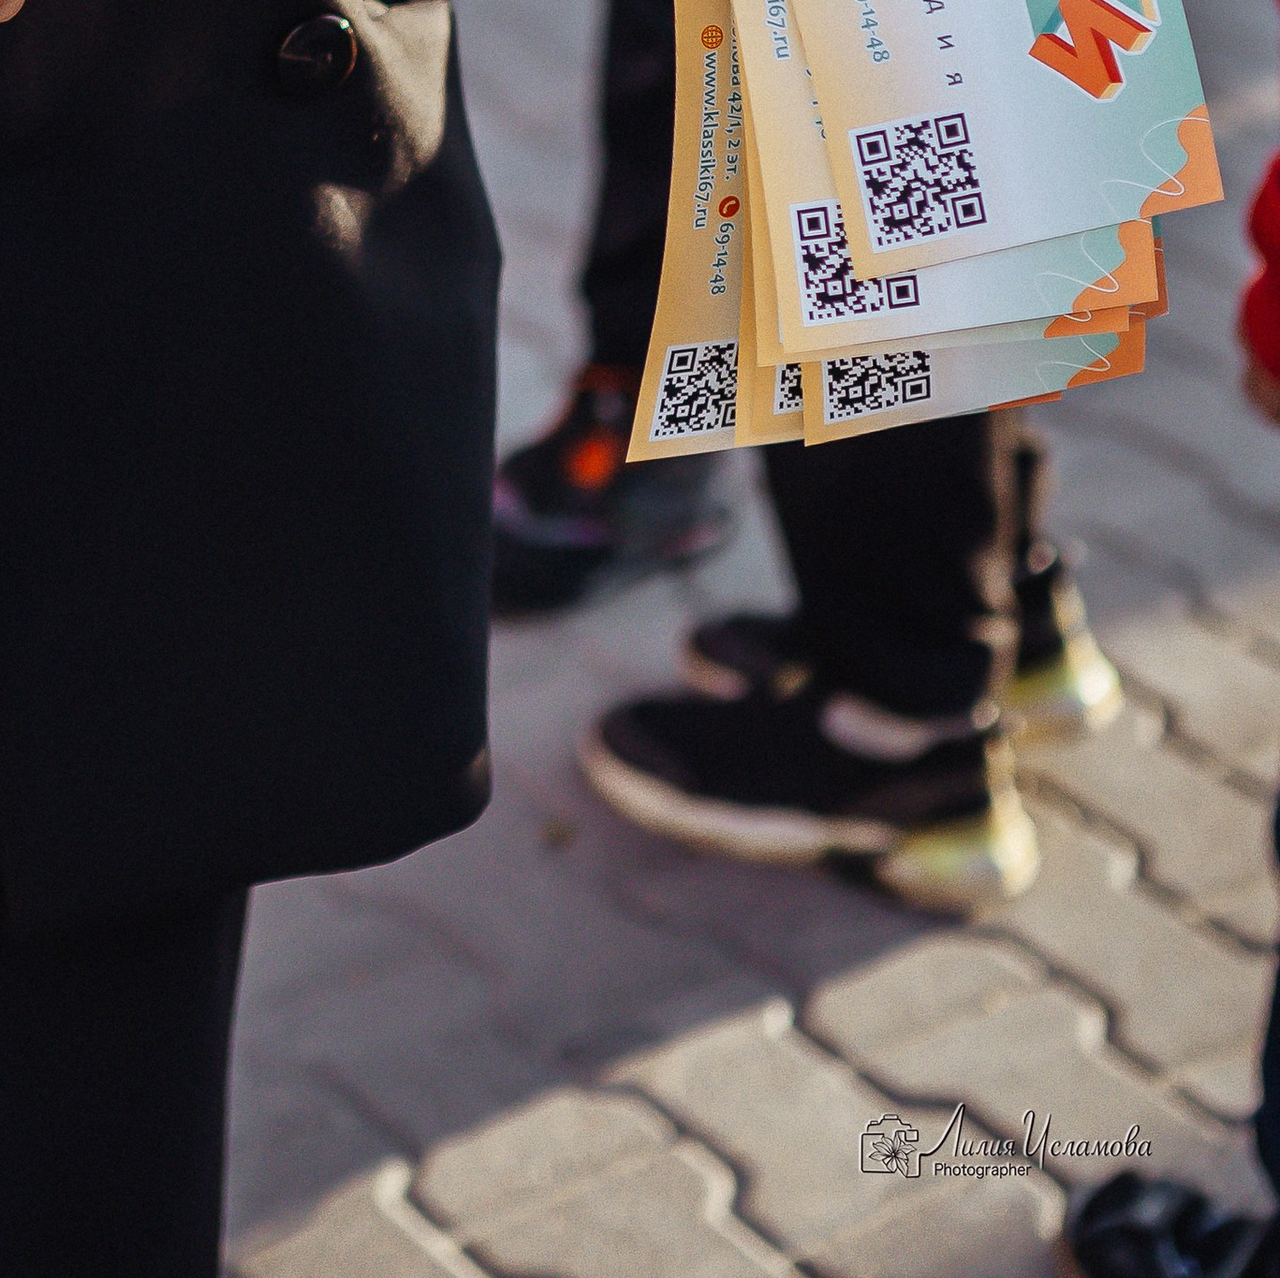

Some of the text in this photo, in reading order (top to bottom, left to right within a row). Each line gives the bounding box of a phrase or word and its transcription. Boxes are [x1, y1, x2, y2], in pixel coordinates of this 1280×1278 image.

[693, 51, 720, 228] www.klassiki67.ru
[727, 139, 741, 149] 2
[724, 153, 740, 181] эт.
[710, 222, 735, 295] 69-14-48
